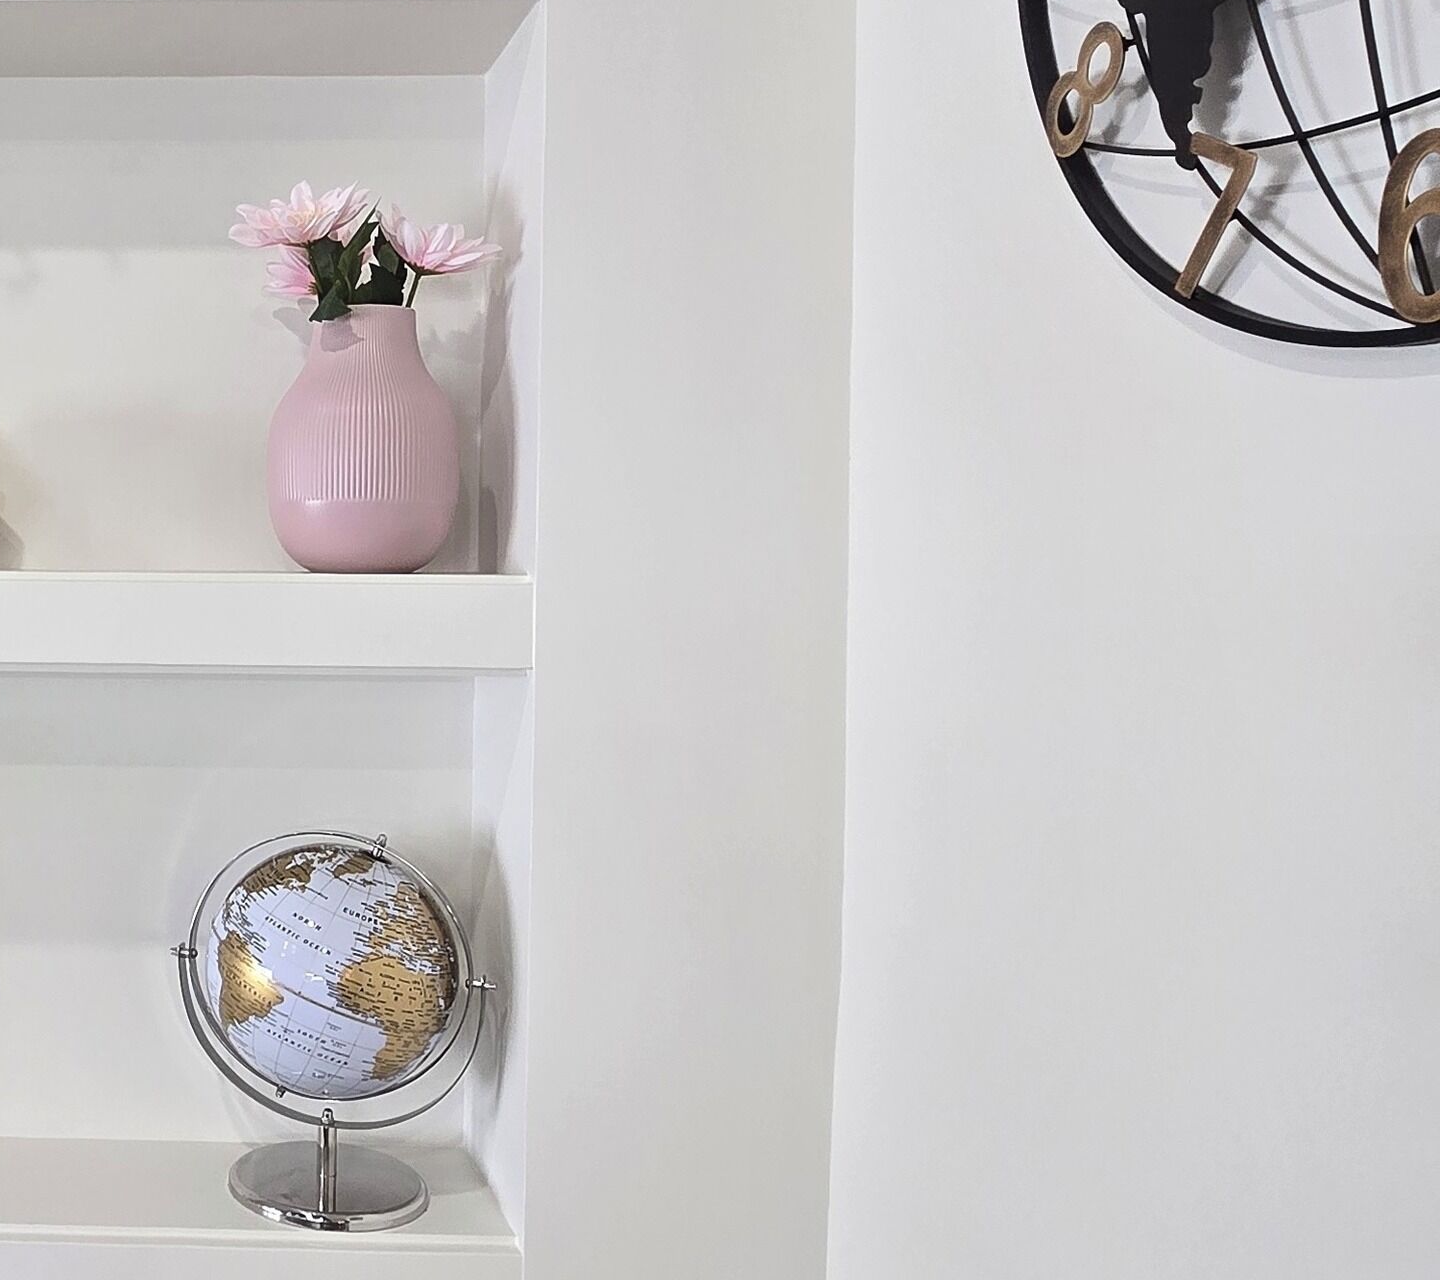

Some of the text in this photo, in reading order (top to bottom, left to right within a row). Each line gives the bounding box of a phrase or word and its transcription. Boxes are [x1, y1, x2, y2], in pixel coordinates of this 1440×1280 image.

[1047, 21, 1124, 157] 8
[1174, 131, 1258, 299] 7
[292, 911, 322, 932] NORH
[342, 906, 379, 926] EUROPE
